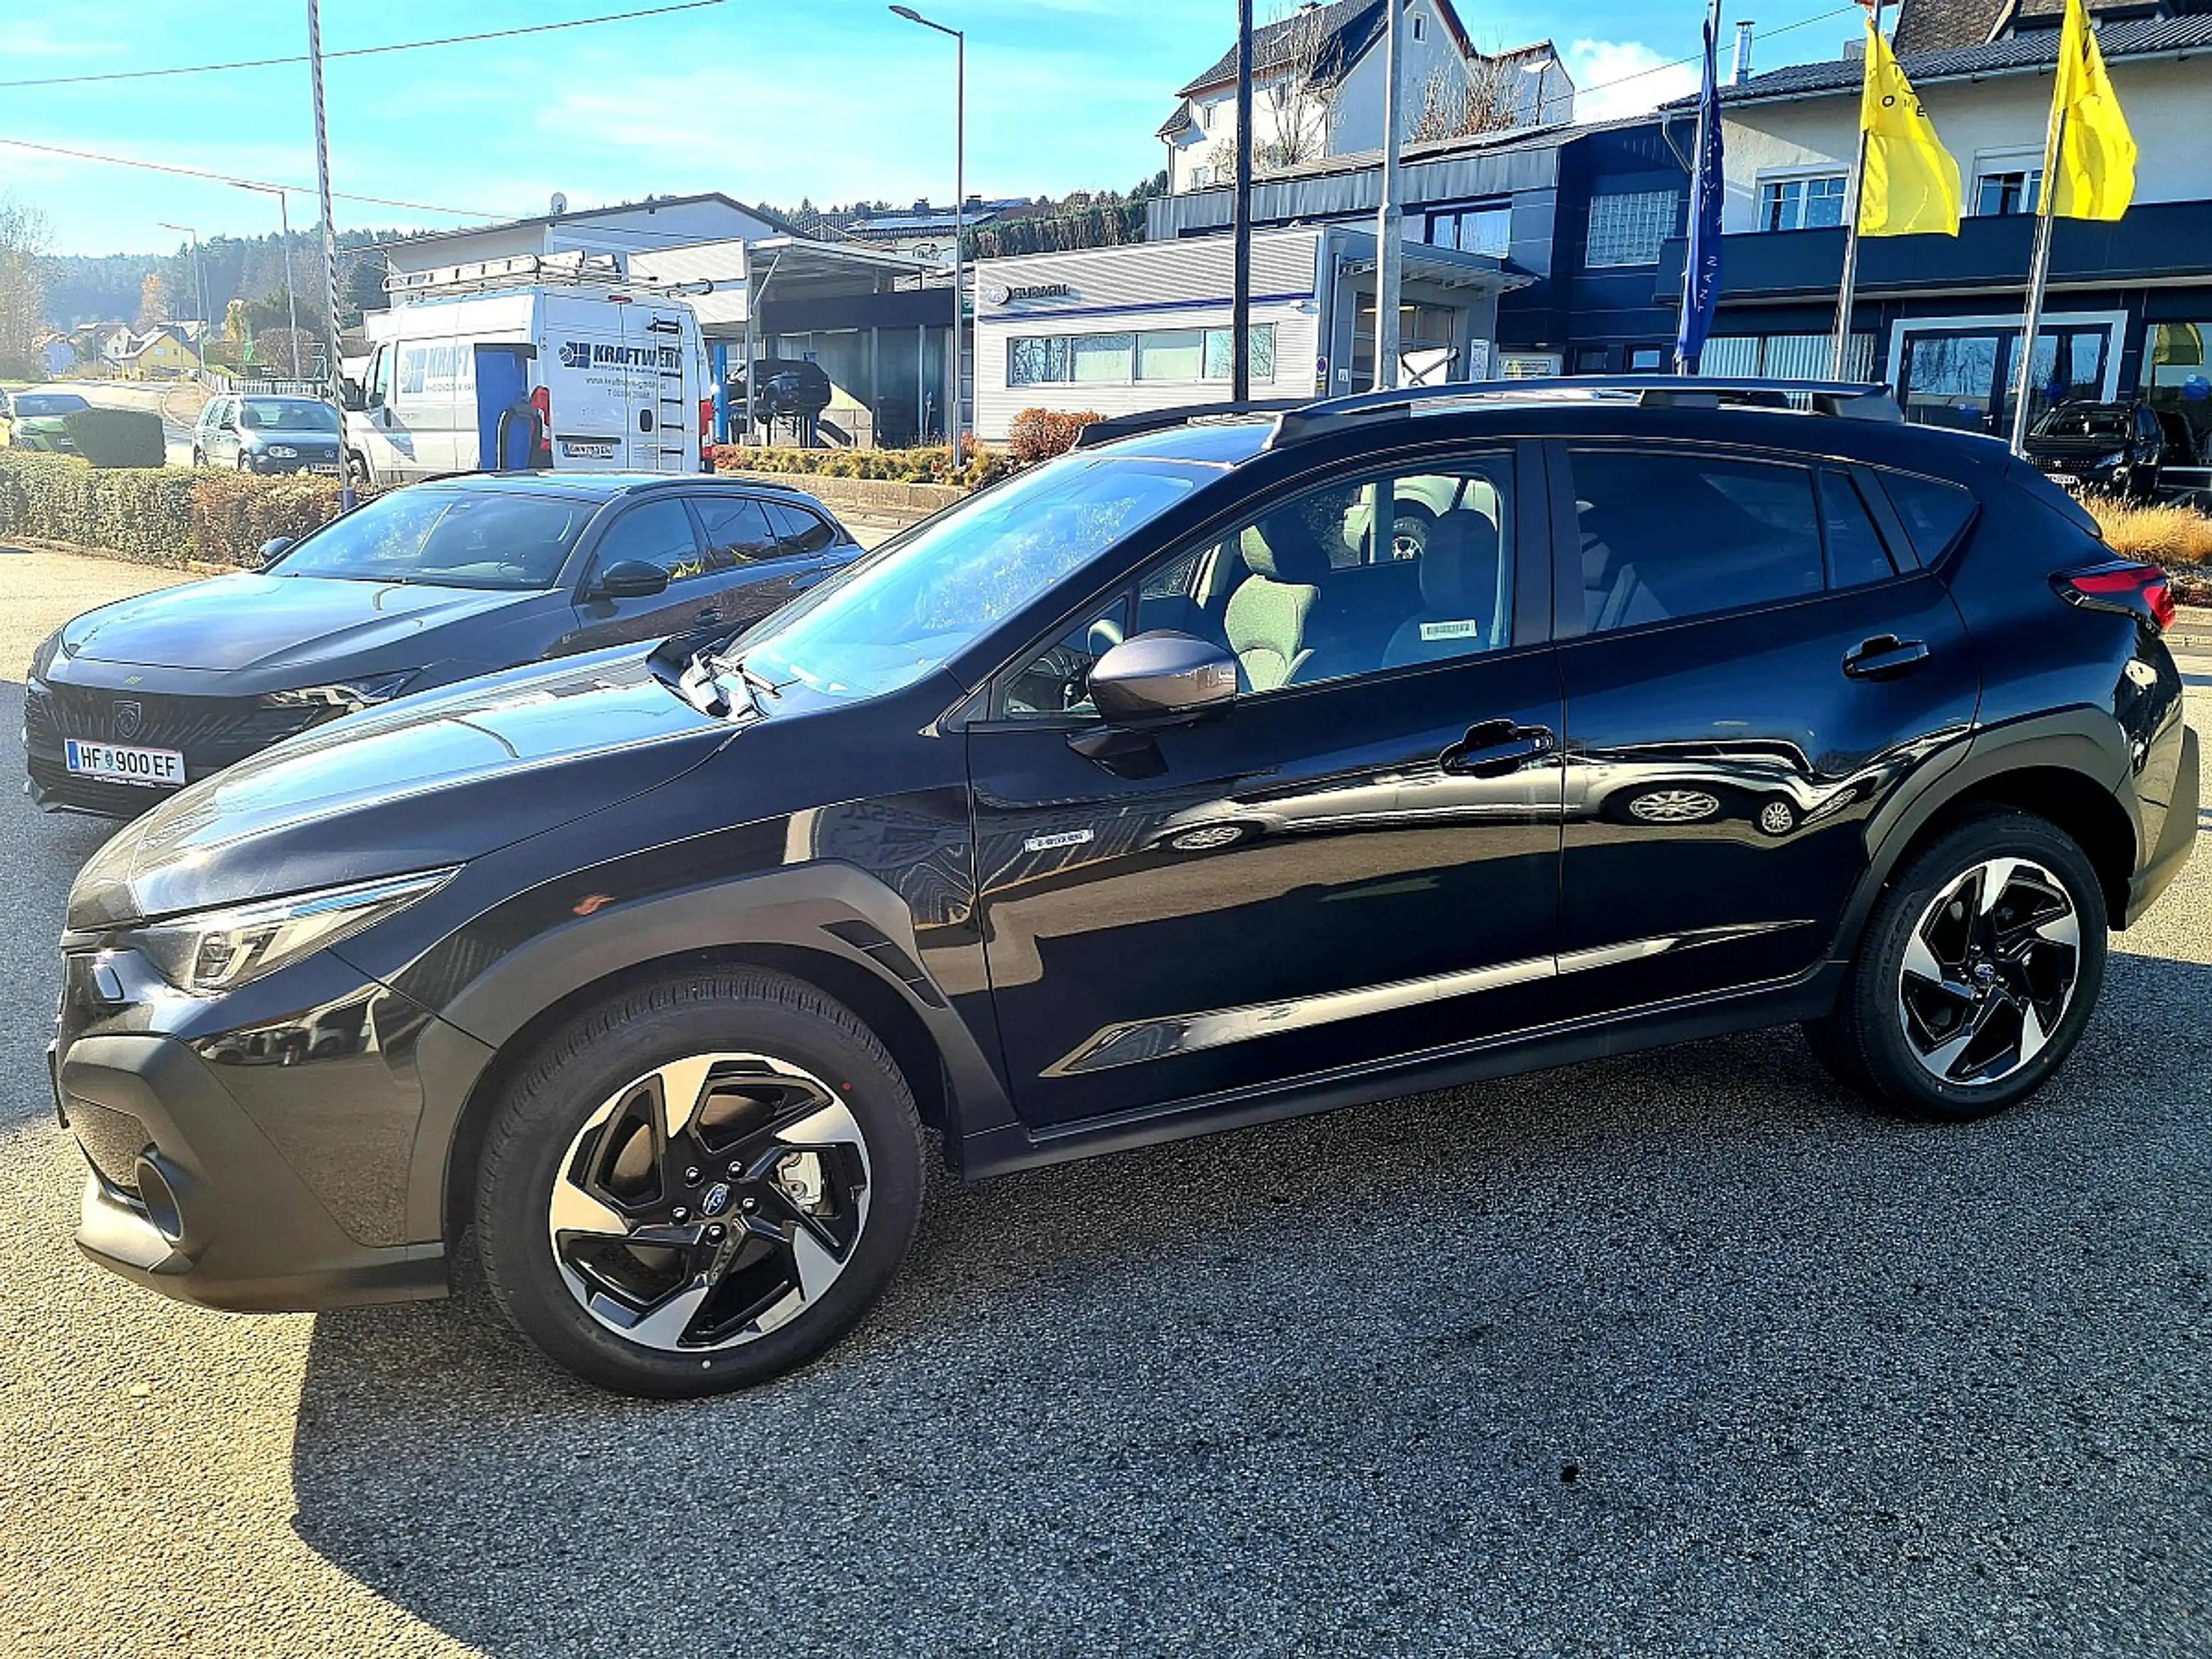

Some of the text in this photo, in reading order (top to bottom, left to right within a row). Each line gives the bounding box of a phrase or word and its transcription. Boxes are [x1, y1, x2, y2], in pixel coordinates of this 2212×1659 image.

[81, 747, 176, 777] HF 900 EF
